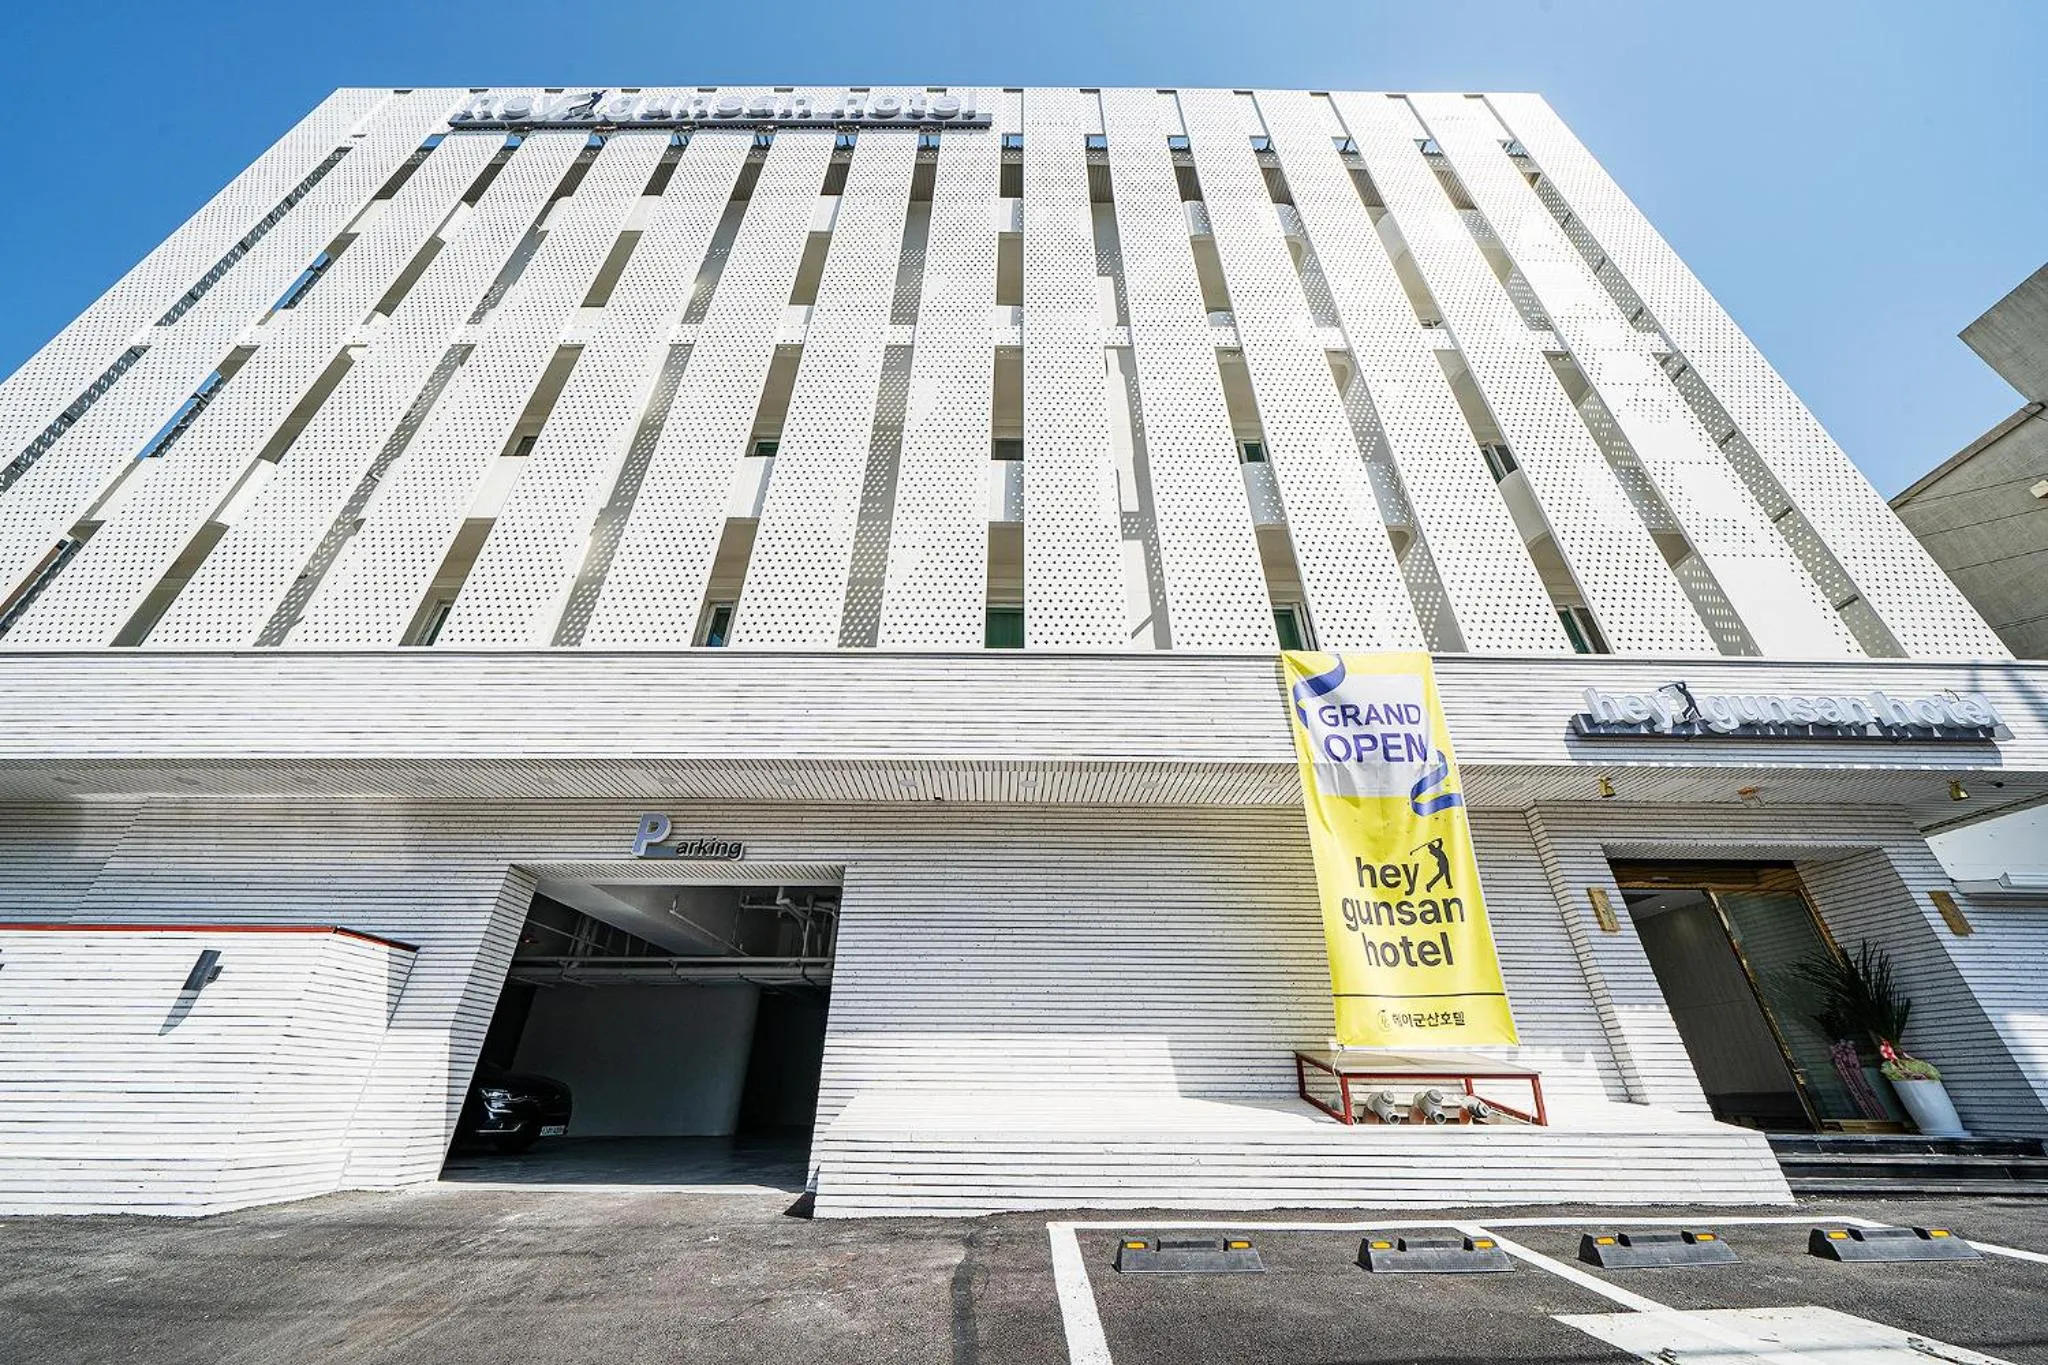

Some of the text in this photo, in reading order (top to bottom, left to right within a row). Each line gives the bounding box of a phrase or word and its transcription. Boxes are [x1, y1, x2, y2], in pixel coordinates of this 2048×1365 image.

[1318, 703, 1421, 727] GRAND
[1583, 687, 2002, 734] hey gunsan hotel
[1323, 732, 1428, 763] OPEN
[1355, 856, 1420, 896] hey
[1341, 897, 1465, 932] gunsan
[1361, 932, 1454, 967] hotel
